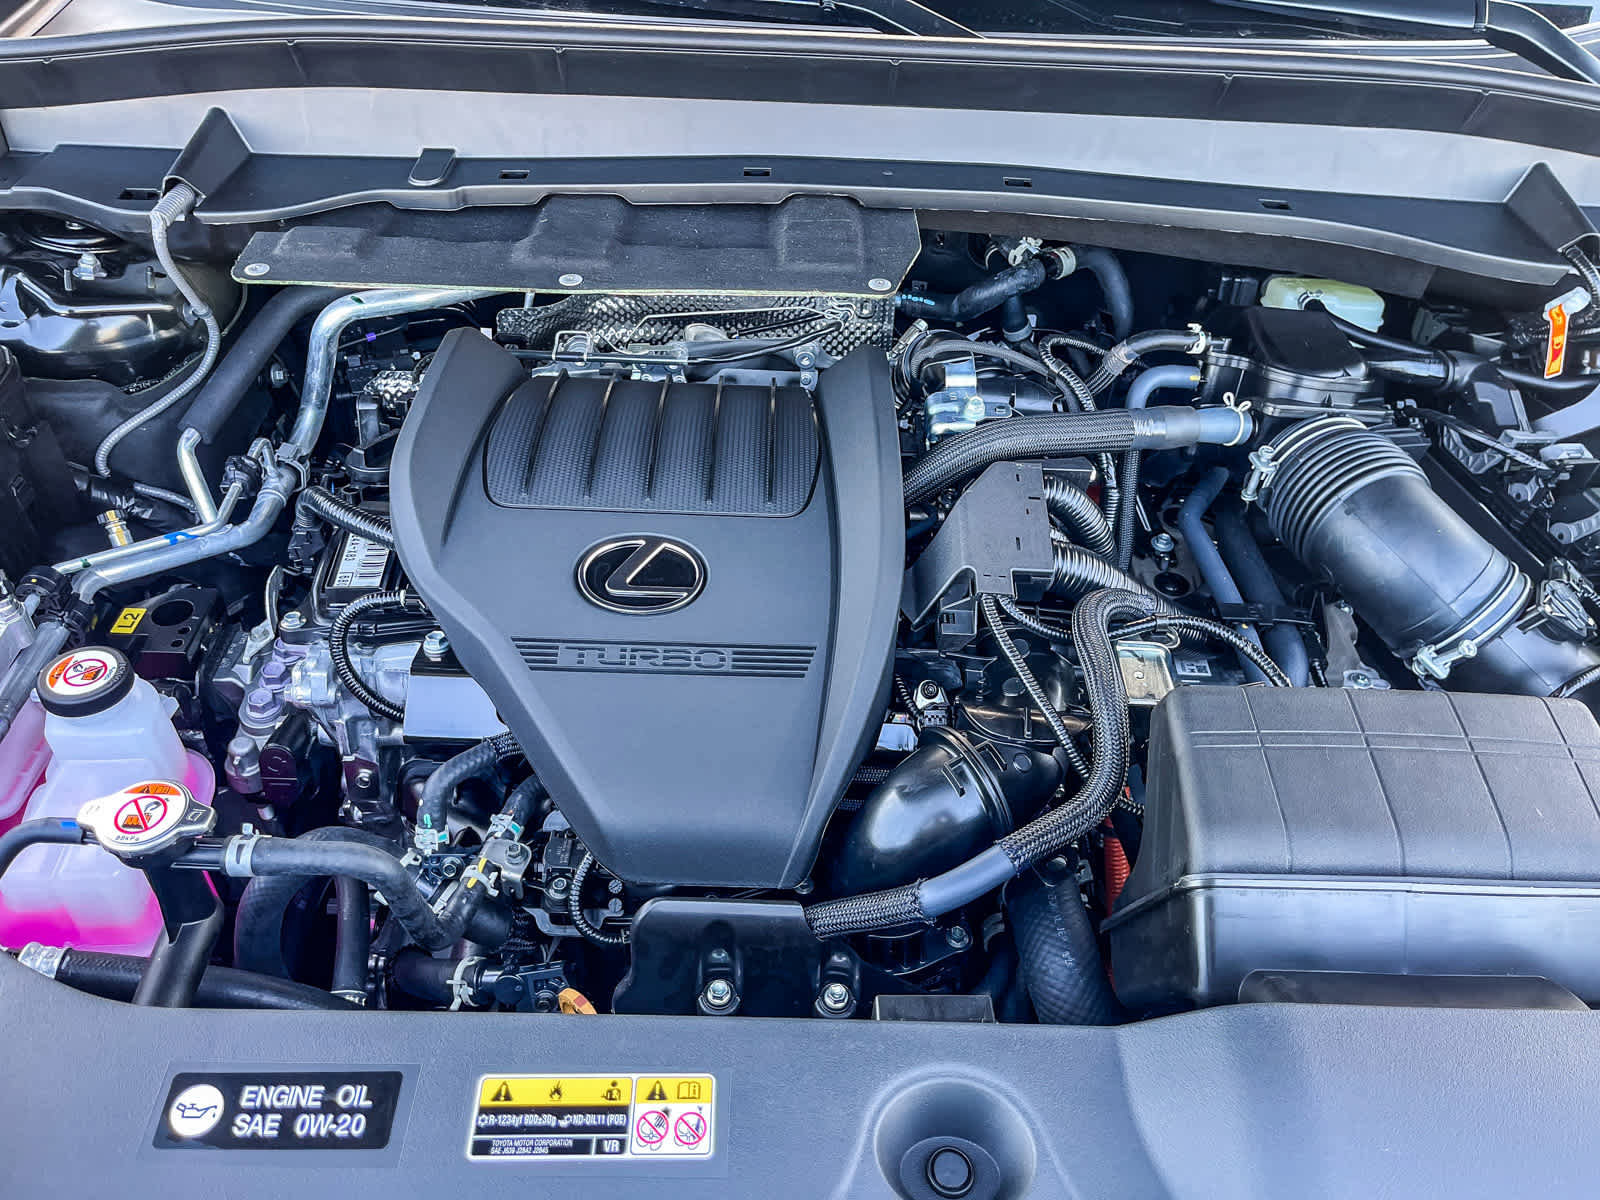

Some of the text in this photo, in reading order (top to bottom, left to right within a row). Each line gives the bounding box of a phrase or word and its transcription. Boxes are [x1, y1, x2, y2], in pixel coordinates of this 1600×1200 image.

[117, 613, 141, 629] L2
[563, 645, 730, 670] TURBO
[240, 1085, 373, 1109] ENGINE OIL
[232, 1114, 366, 1138] SAE 0W-20
[492, 1138, 574, 1147] TOYOTA MOTOR CORPORATION
[604, 1140, 620, 1152] VR
